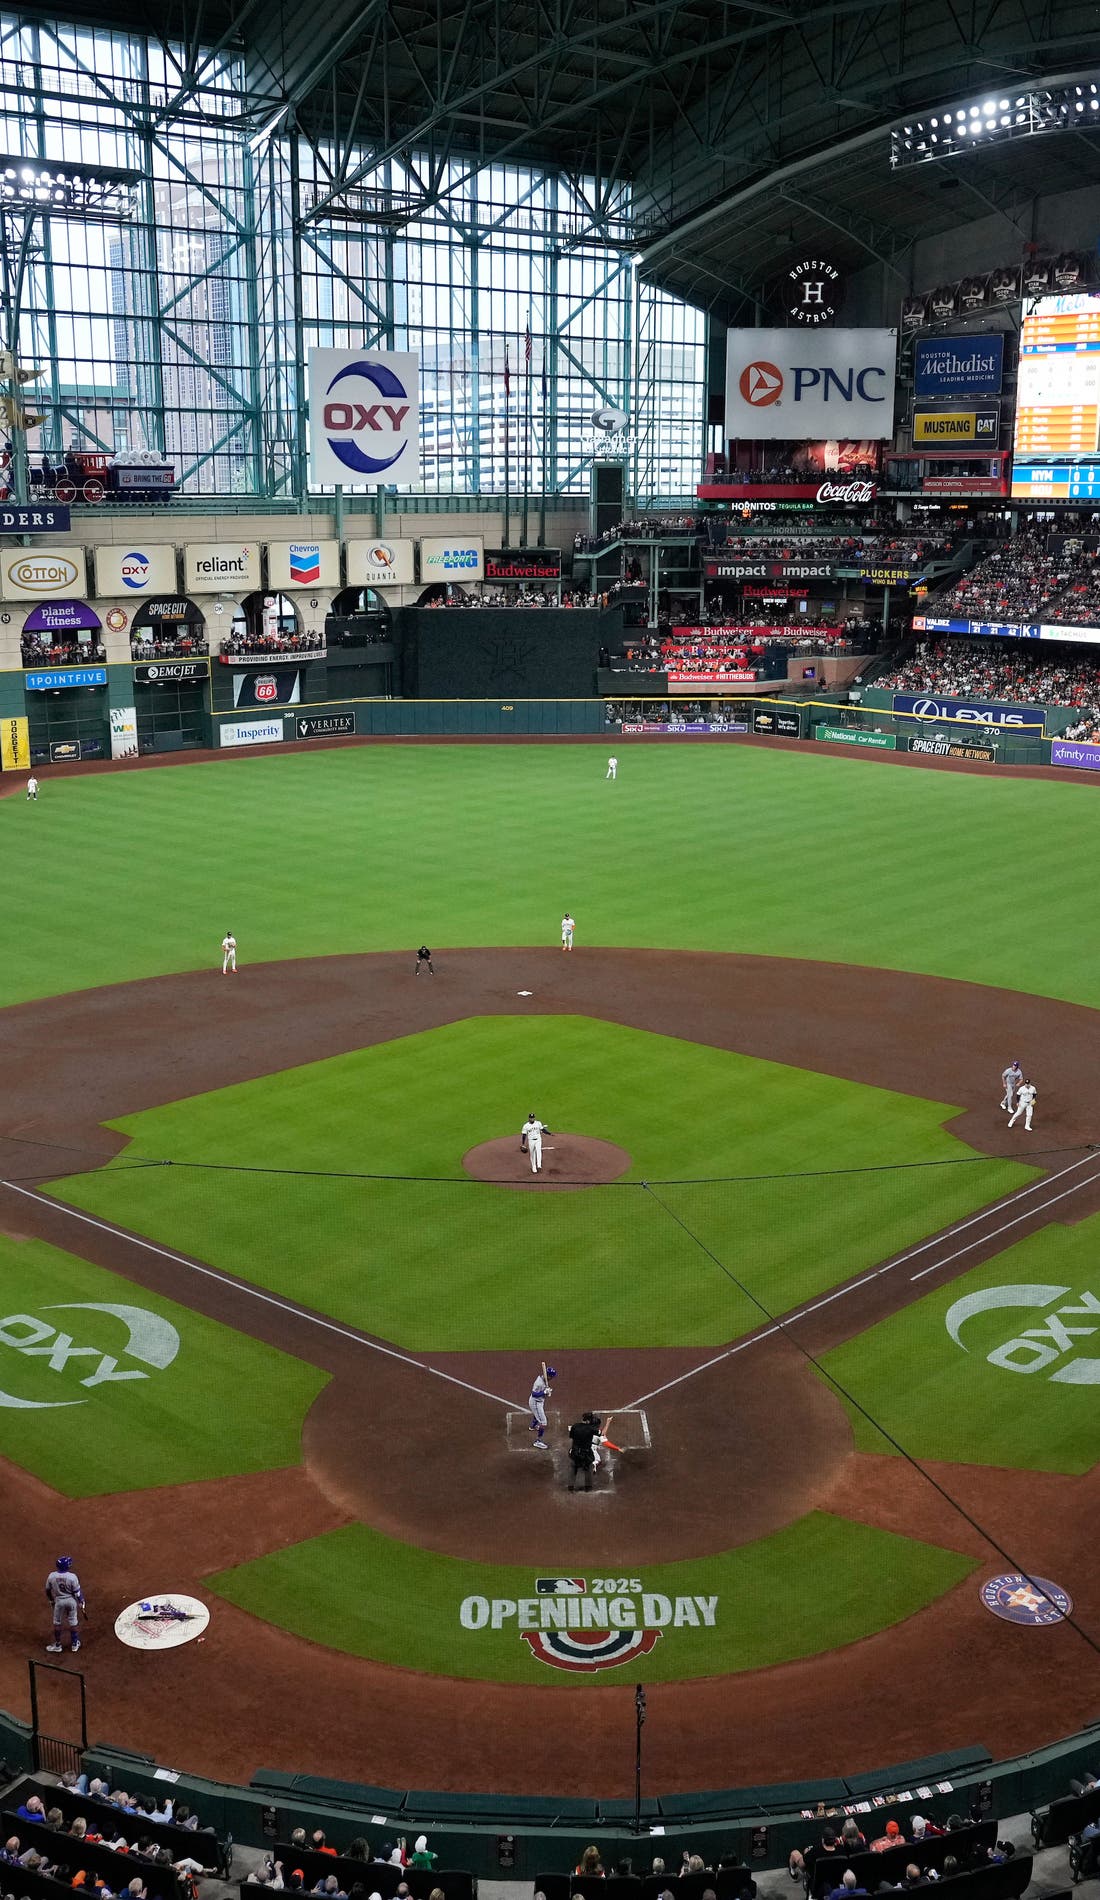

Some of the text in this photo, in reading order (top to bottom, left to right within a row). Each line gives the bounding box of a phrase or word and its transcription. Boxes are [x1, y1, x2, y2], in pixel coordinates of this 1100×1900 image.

[789, 260, 839, 280] HOUSTON
[802, 282, 825, 304] H
[790, 306, 835, 323] ASTROS
[921, 353, 996, 376] Methodist
[789, 367, 886, 403] PNC
[939, 375, 965, 383] LEADING
[324, 403, 410, 431] OXY
[923, 419, 995, 434] MUSTANG CAT
[152, 474, 162, 482] THE
[1031, 470, 1095, 482] NYM 0 0
[816, 481, 877, 503] Coca-Cola
[1072, 485, 1080, 496] 0
[1087, 486, 1093, 496] 1
[731, 502, 776, 511] HORNITOS
[3, 513, 55, 526] DERS
[773, 527, 813, 535] HORNITOS
[289, 544, 320, 552] Chevron
[196, 556, 244, 572] reliant
[427, 550, 478, 568] FREEPORT LNG
[18, 565, 68, 583] COTTON
[122, 566, 148, 575] OXY
[366, 572, 397, 581] QUANTA
[486, 563, 560, 577] Budweiser
[717, 565, 831, 578] impact impact
[860, 569, 910, 579] PLUCKERS
[742, 585, 810, 597] Budweiser
[42, 606, 75, 618] planet
[148, 602, 188, 615] SPACE CITY
[46, 616, 82, 626] fitness
[926, 618, 951, 626] VALDEZ
[783, 627, 828, 637] Budweiser
[1023, 625, 1031, 637] K
[158, 665, 197, 676] EMCJET
[679, 672, 714, 680] Budweiser
[31, 672, 102, 686] 1POINTFIVE
[259, 686, 273, 696] 66
[942, 707, 1023, 725] LEXUS
[113, 724, 135, 732] WM
[311, 718, 351, 729] VERITEX
[237, 726, 280, 738] Insperity
[983, 727, 1000, 735] 370
[10, 720, 19, 764] DOGGETT
[831, 731, 856, 742] National
[868, 736, 887, 745] Rental
[912, 739, 992, 761] SPACE CITY HOME NETWORK
[1055, 747, 1085, 762] xfinity
[592, 1578, 643, 1594] 2025
[985, 1576, 1023, 1607] HOUSTON
[460, 1594, 719, 1630] OPENING DAY
